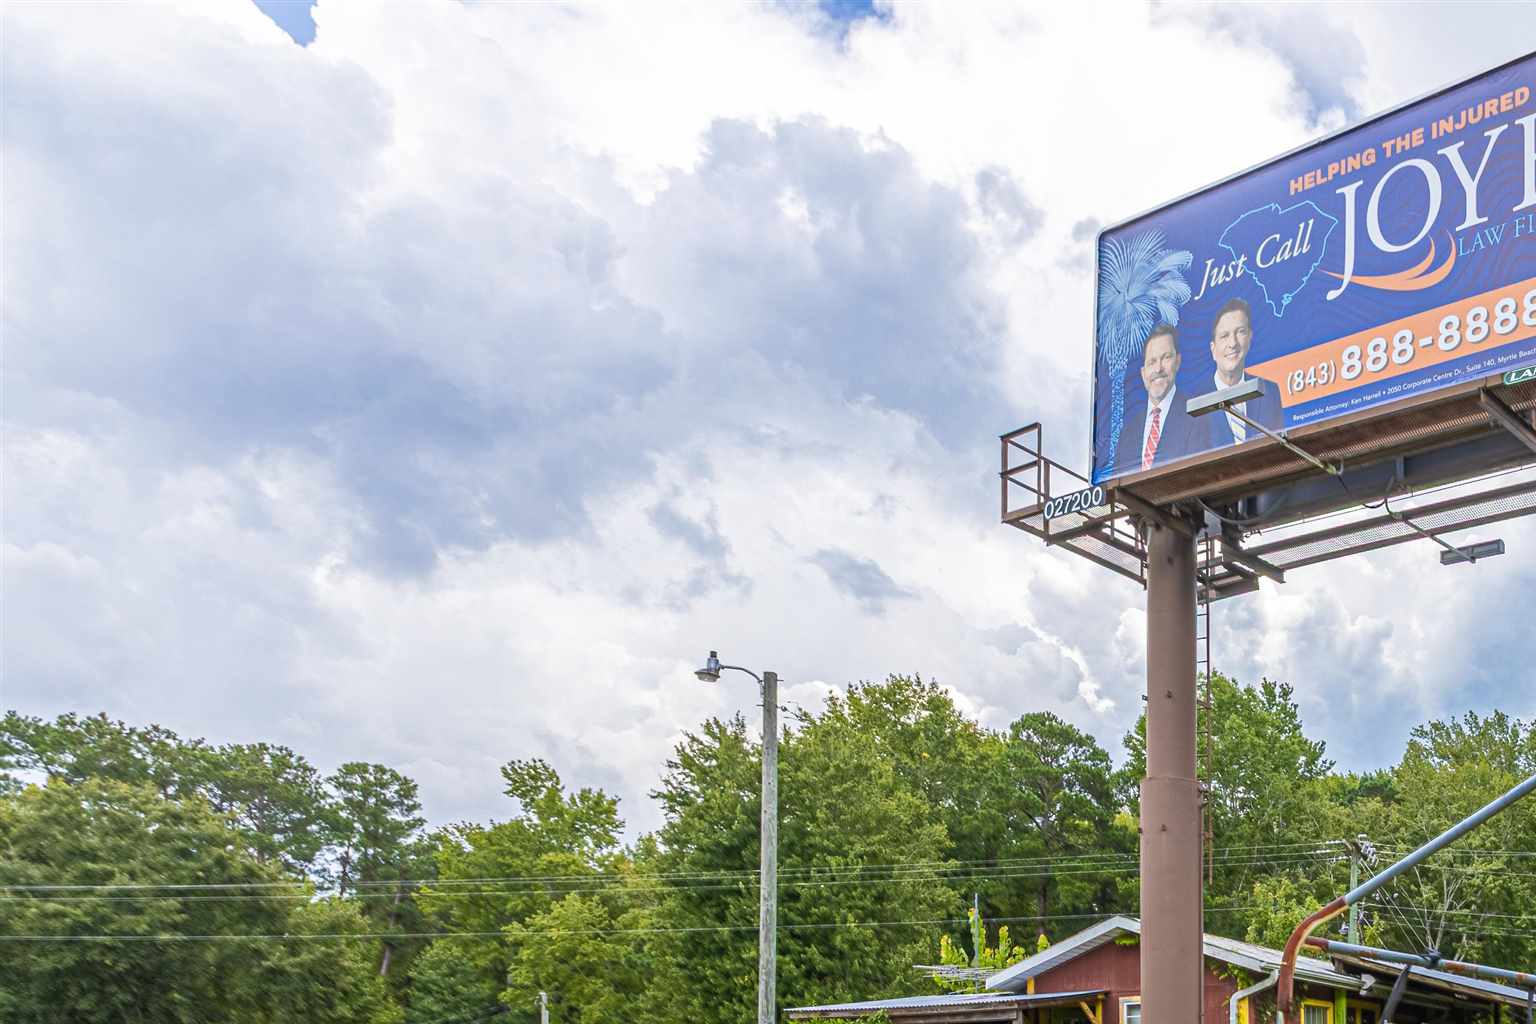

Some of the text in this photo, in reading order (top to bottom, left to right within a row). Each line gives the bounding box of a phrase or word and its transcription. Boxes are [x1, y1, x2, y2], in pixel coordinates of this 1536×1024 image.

[1289, 86, 1530, 195] HELPING THE INJURED
[1458, 223, 1507, 256] LAW
[1194, 218, 1314, 300] Just Call
[1287, 359, 1336, 395] (843)
[1044, 486, 1103, 520] 027200
